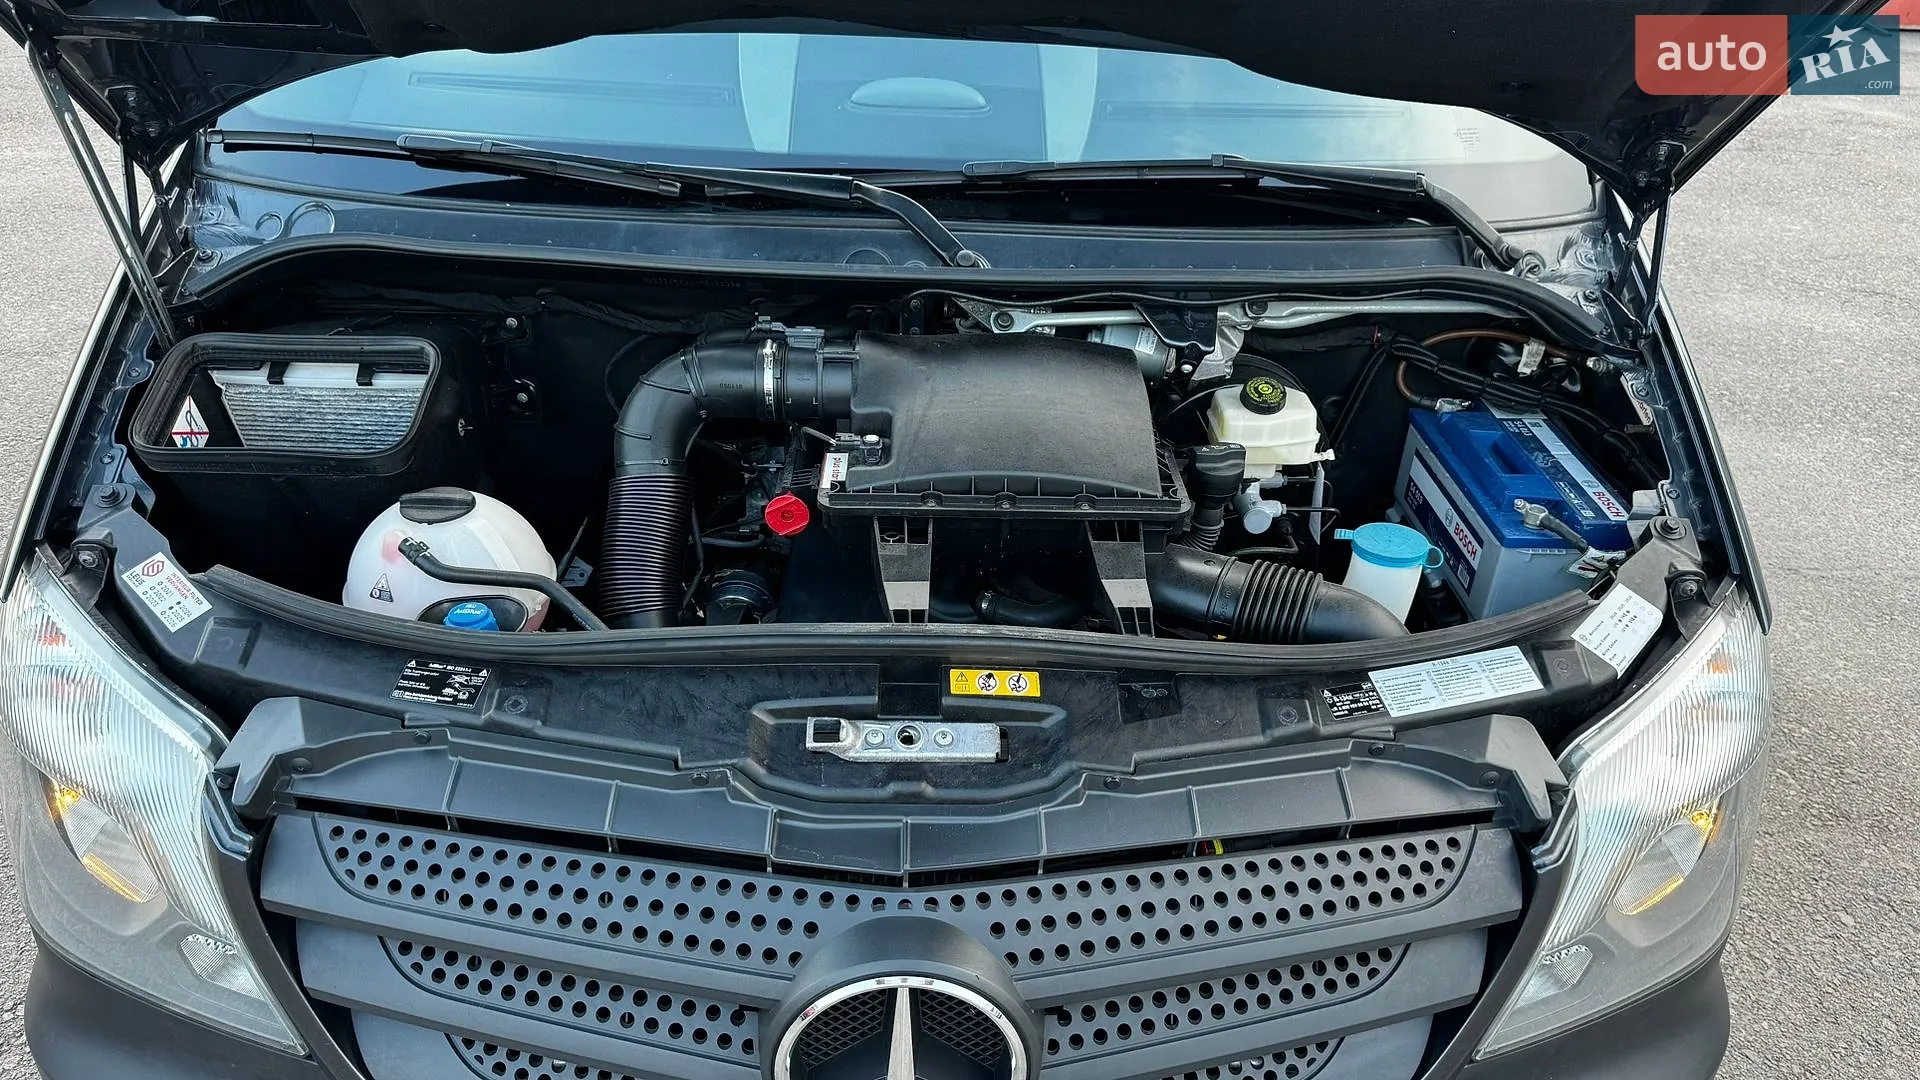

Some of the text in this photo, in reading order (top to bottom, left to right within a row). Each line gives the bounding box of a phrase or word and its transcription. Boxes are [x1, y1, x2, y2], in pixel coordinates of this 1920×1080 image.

[1592, 491, 1625, 518] BOSCH
[1453, 522, 1478, 561] BOSCH
[129, 570, 145, 585] LEUS
